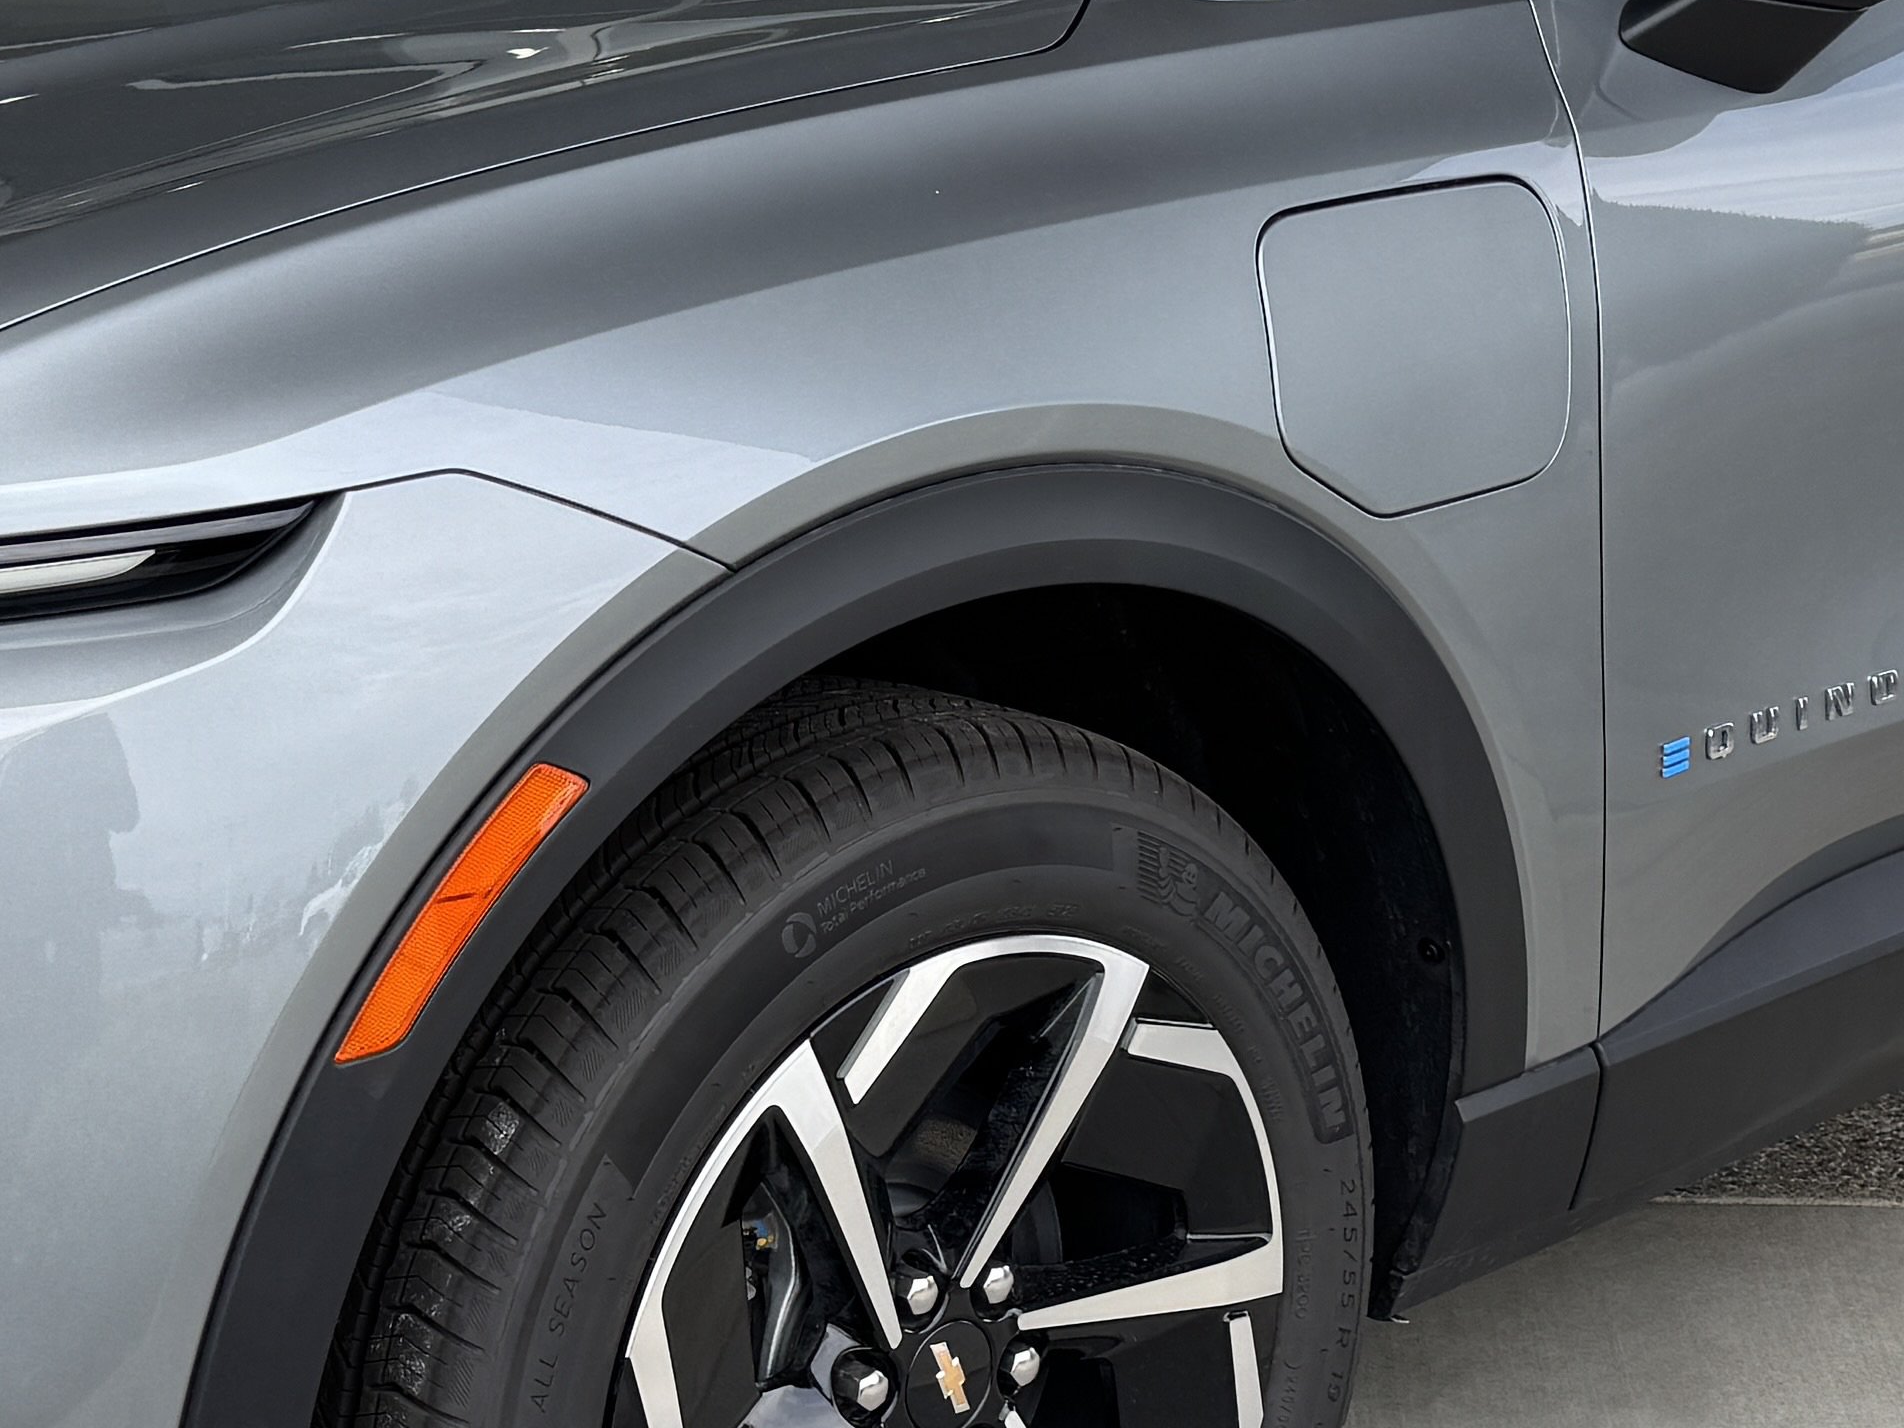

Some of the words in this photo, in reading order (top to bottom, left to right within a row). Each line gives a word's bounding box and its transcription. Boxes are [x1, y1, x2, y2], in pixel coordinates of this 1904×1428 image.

[816, 859, 895, 917] MICHELIN
[820, 910, 849, 934] Total
[849, 867, 927, 914] Performance
[1203, 889, 1347, 1130] MICHELIN
[529, 1352, 560, 1414] ALL
[548, 1202, 608, 1340] SEASON
[1339, 1177, 1360, 1310] 245/55
